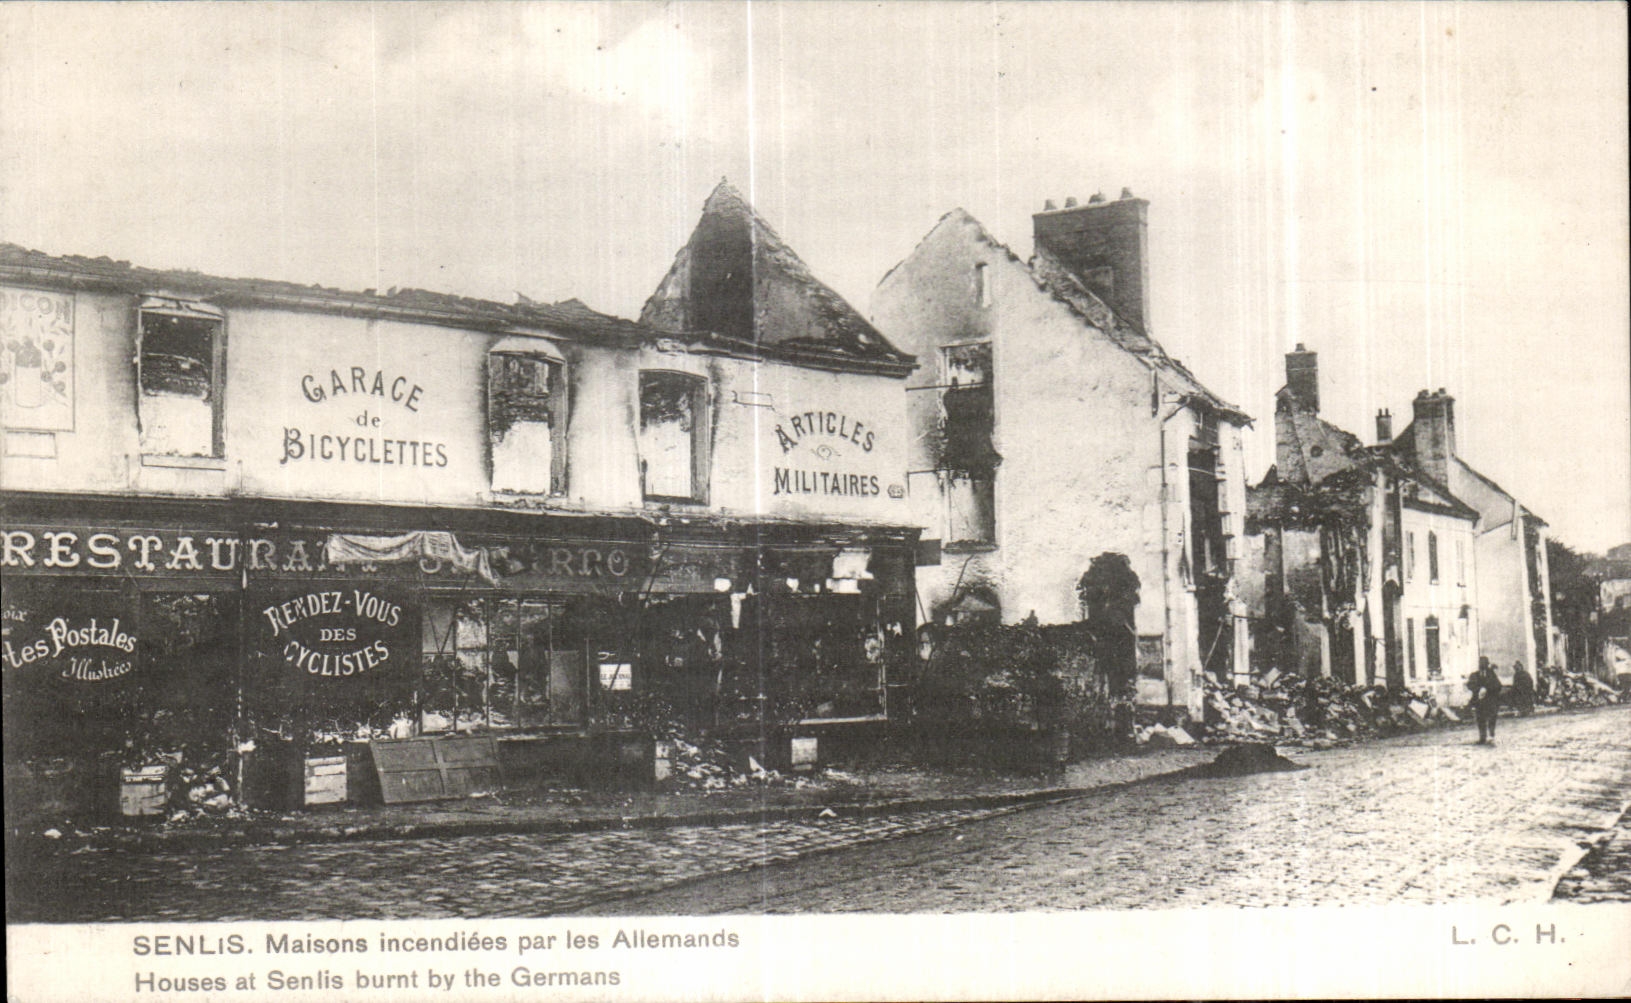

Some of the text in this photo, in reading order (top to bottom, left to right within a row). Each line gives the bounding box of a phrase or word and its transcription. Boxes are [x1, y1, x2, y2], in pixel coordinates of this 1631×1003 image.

[355, 409, 381, 428] de
[774, 411, 876, 454] ARTICLES
[279, 426, 449, 468] BICYCLETTES
[773, 466, 880, 497] MILITAIRES
[1, 530, 377, 572] RESTAURA
[263, 589, 402, 637] RENDEZ-VOUS
[2, 617, 137, 669] tes Postales
[319, 628, 357, 642] DES
[283, 639, 390, 677] CYCLISTES
